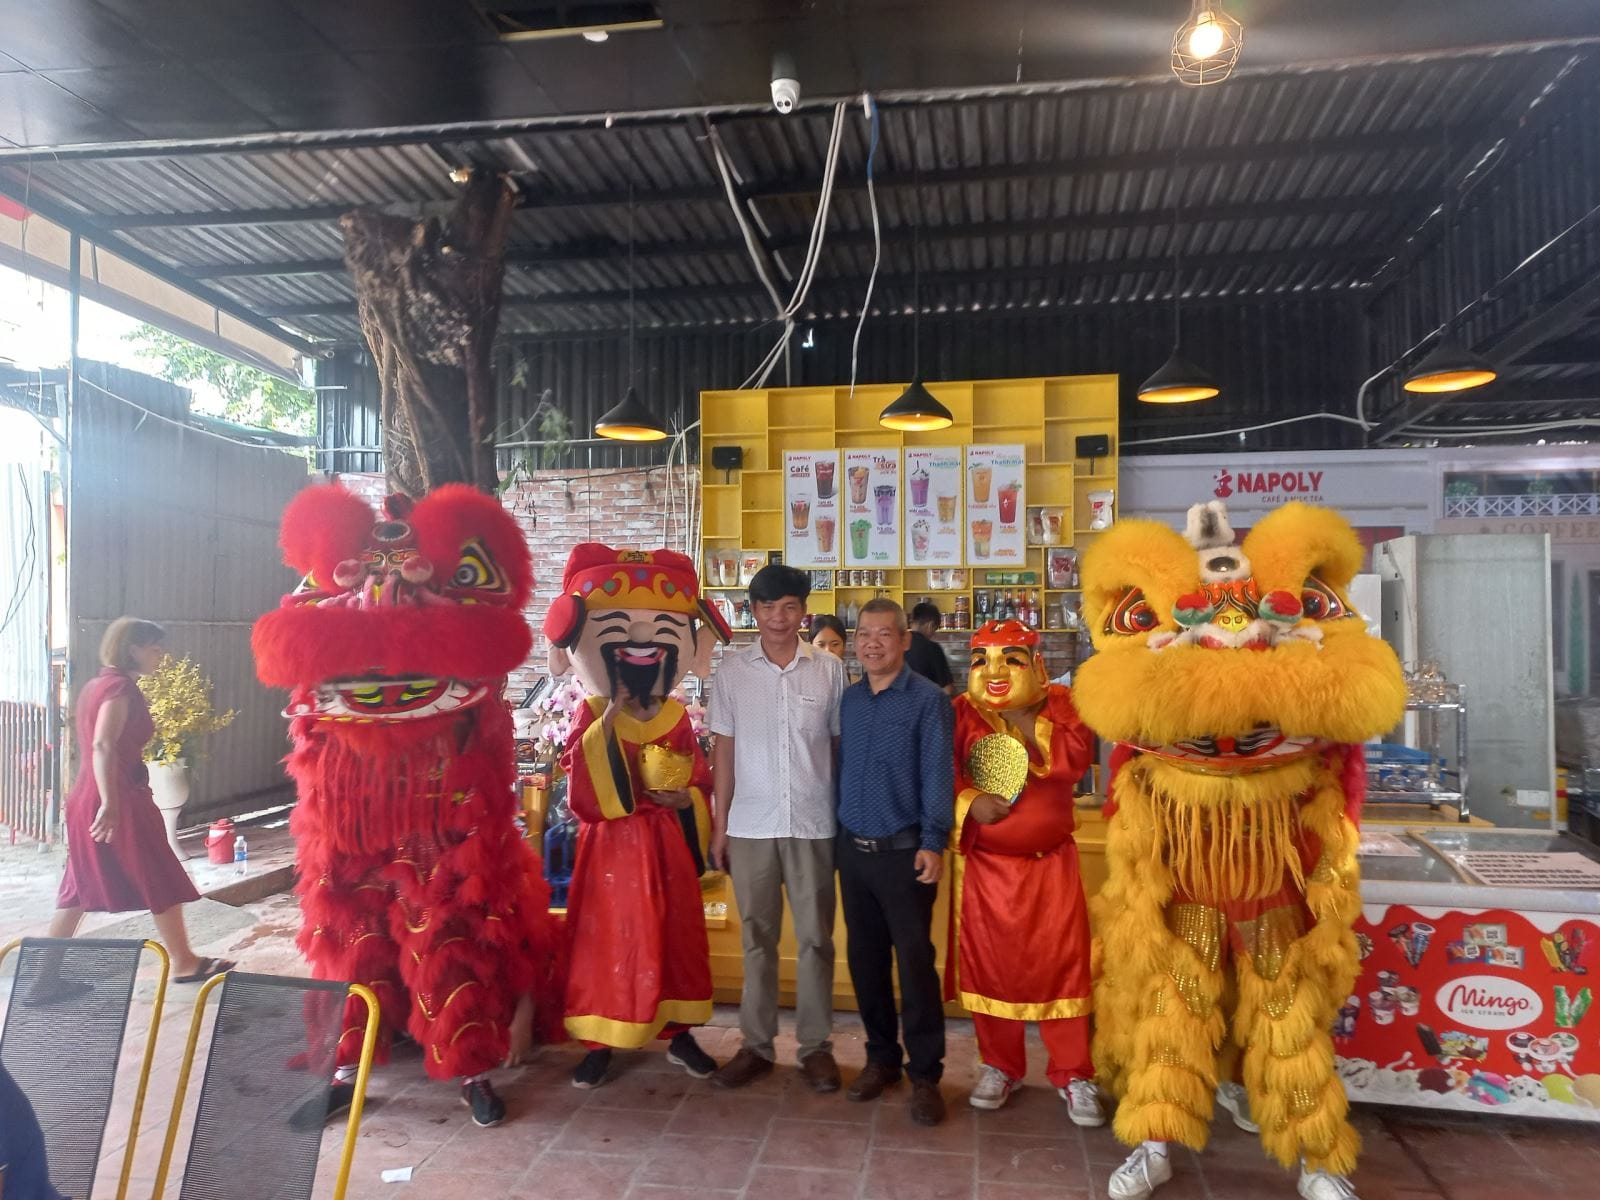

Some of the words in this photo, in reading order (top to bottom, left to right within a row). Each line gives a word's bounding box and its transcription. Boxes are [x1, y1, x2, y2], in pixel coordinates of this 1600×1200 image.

[790, 465, 810, 473] Café
[1237, 472, 1323, 493] NAPOLY
[1503, 521, 1600, 538] COFFEE
[1448, 984, 1529, 1016] Mingo
